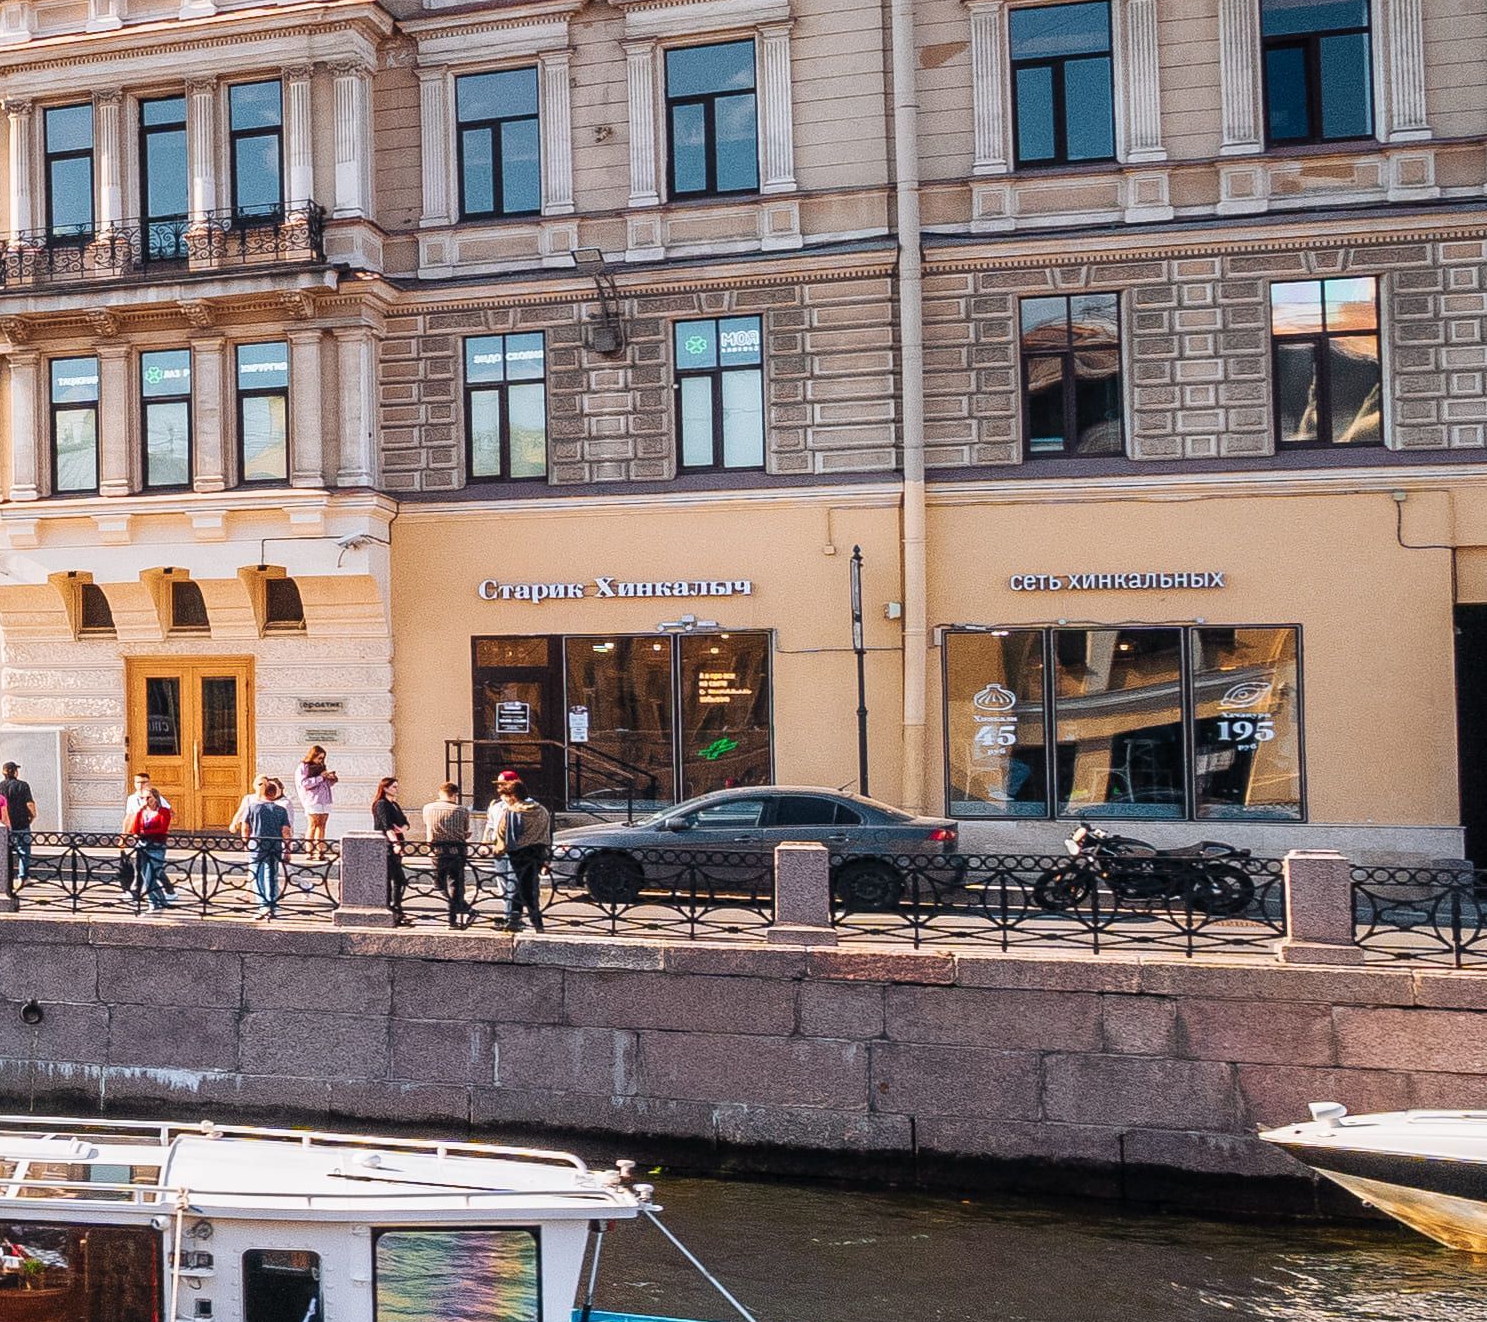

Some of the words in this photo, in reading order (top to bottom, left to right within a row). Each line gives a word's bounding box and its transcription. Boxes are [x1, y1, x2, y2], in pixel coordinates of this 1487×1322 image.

[721, 330, 759, 346] МОЯ
[478, 579, 584, 604] Старик
[594, 577, 752, 599] Хинкалыч
[1010, 574, 1061, 591] сеть
[1068, 572, 1224, 590] хинкальных
[975, 725, 1016, 746] 45
[1217, 721, 1274, 741] 195
